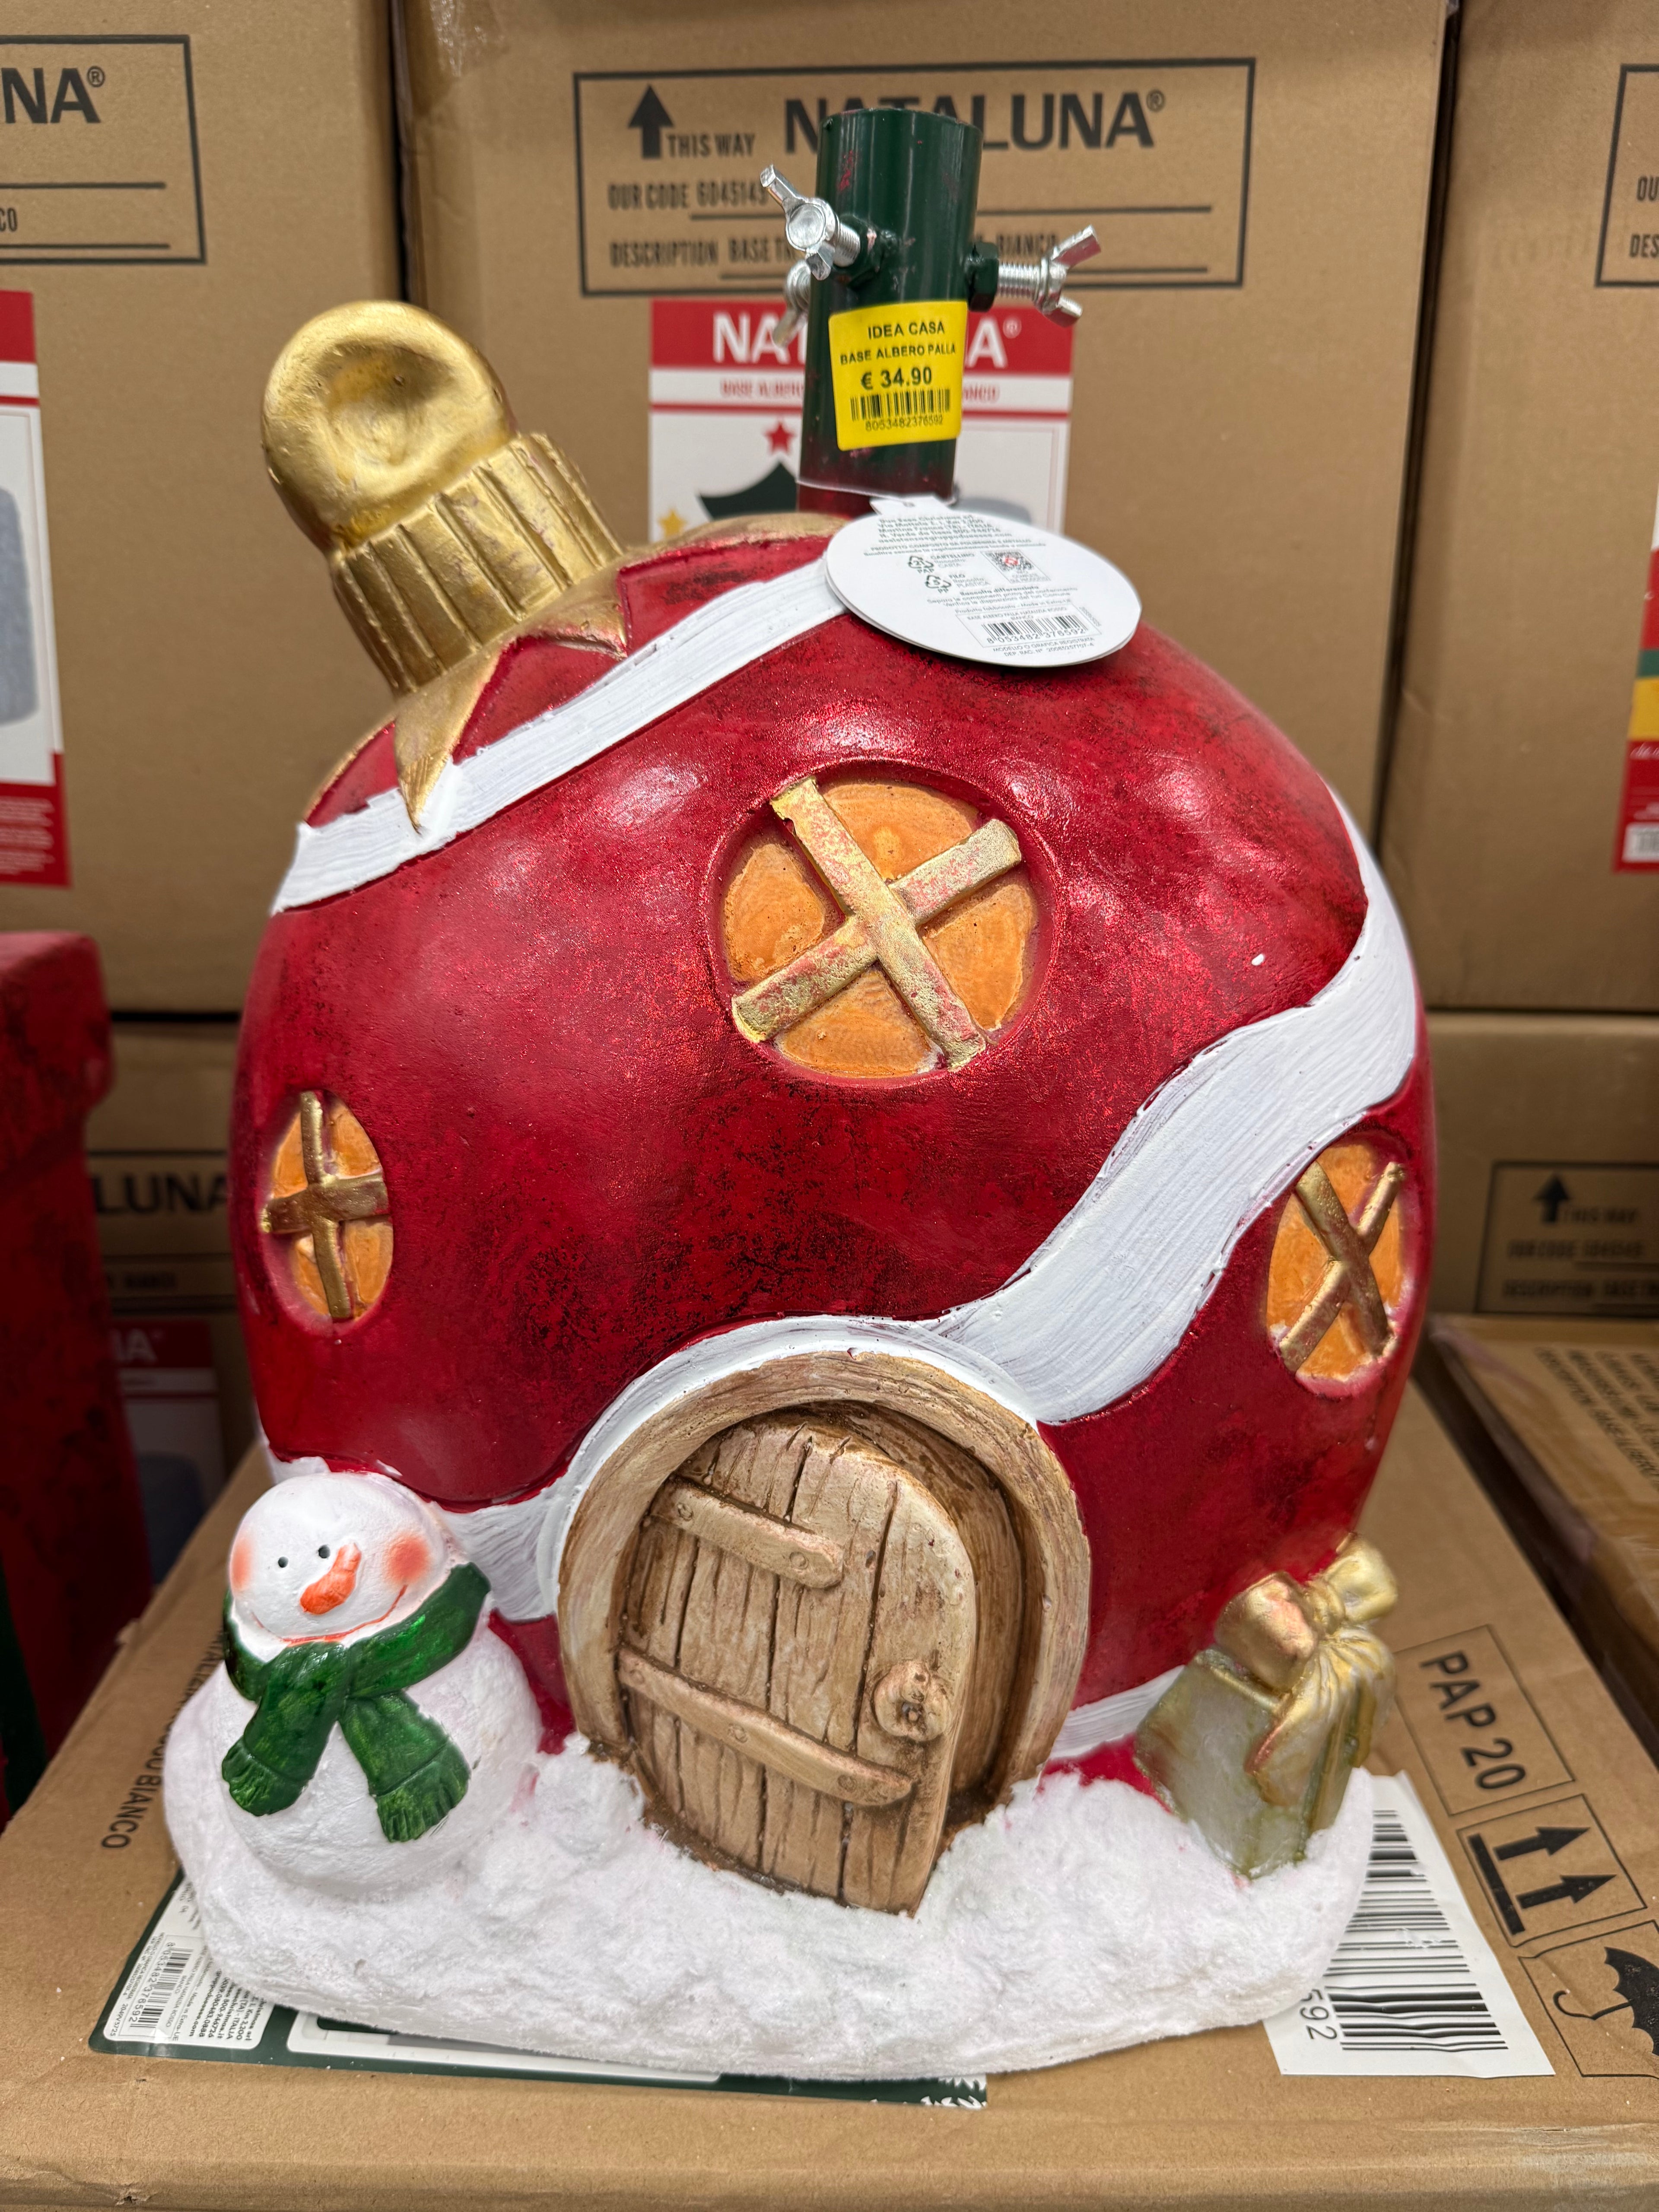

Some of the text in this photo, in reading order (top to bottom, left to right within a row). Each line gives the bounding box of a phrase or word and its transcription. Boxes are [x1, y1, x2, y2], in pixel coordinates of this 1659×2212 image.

[667, 133, 755, 157] THIS WAY
[609, 182, 642, 210] OUR
[646, 182, 690, 209] CODE
[610, 241, 719, 267] DESCRIPTION
[868, 321, 945, 340] IDEA CASA
[840, 343, 955, 365] BASE ALBERO PALLA
[861, 366, 932, 390] € 34.90
[865, 414, 944, 432] 8053482376592
[996, 633, 1041, 643] 053482
[1041, 628, 1087, 638] 376592
[1420, 1650, 1526, 1789] PAP 20
[101, 1774, 162, 1848] BIANCO
[149, 1950, 172, 1983] 053482
[129, 1987, 153, 2022] 376592
[237, 2000, 248, 2012] (TA)
[245, 2009, 253, 2019] Km
[110, 2004, 128, 2036] 2049V3725
[165, 2010, 176, 2027] ROSSO
[173, 2015, 188, 2041] Extra-UE
[226, 2018, 240, 2039] ITALIA
[237, 2021, 248, 2040] 2,200
